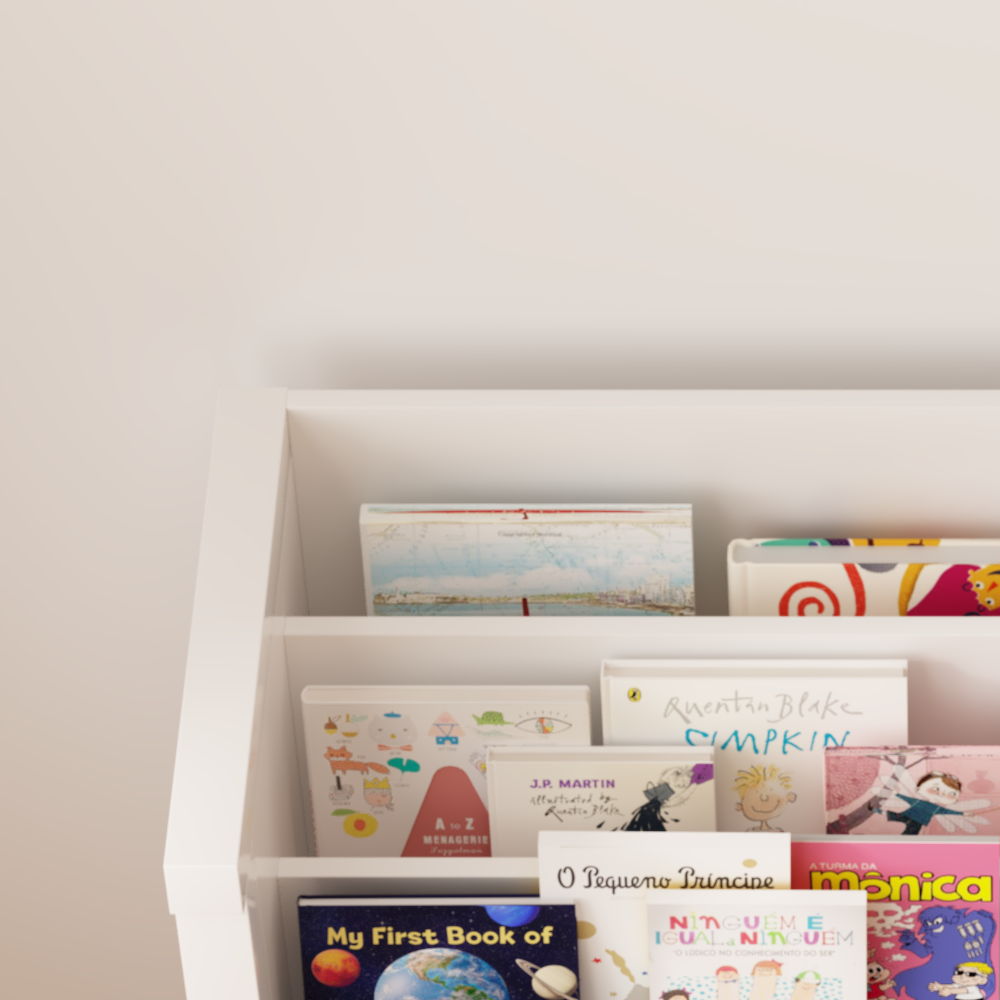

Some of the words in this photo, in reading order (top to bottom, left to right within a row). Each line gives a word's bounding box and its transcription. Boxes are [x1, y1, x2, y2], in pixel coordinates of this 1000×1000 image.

[766, 691, 864, 724] Blake
[530, 779, 552, 789] J.P.
[559, 779, 616, 789] MARTIN
[434, 817, 446, 831] A
[465, 817, 475, 831] Z
[423, 835, 488, 845] MENAGERIE
[809, 862, 819, 871] A
[820, 862, 859, 871] TURMA
[861, 862, 878, 871] DA
[557, 866, 576, 889] O
[582, 866, 672, 895] Pequeno
[327, 927, 364, 950] My
[372, 926, 440, 946] First
[446, 925, 516, 946] Book
[523, 925, 554, 946] of
